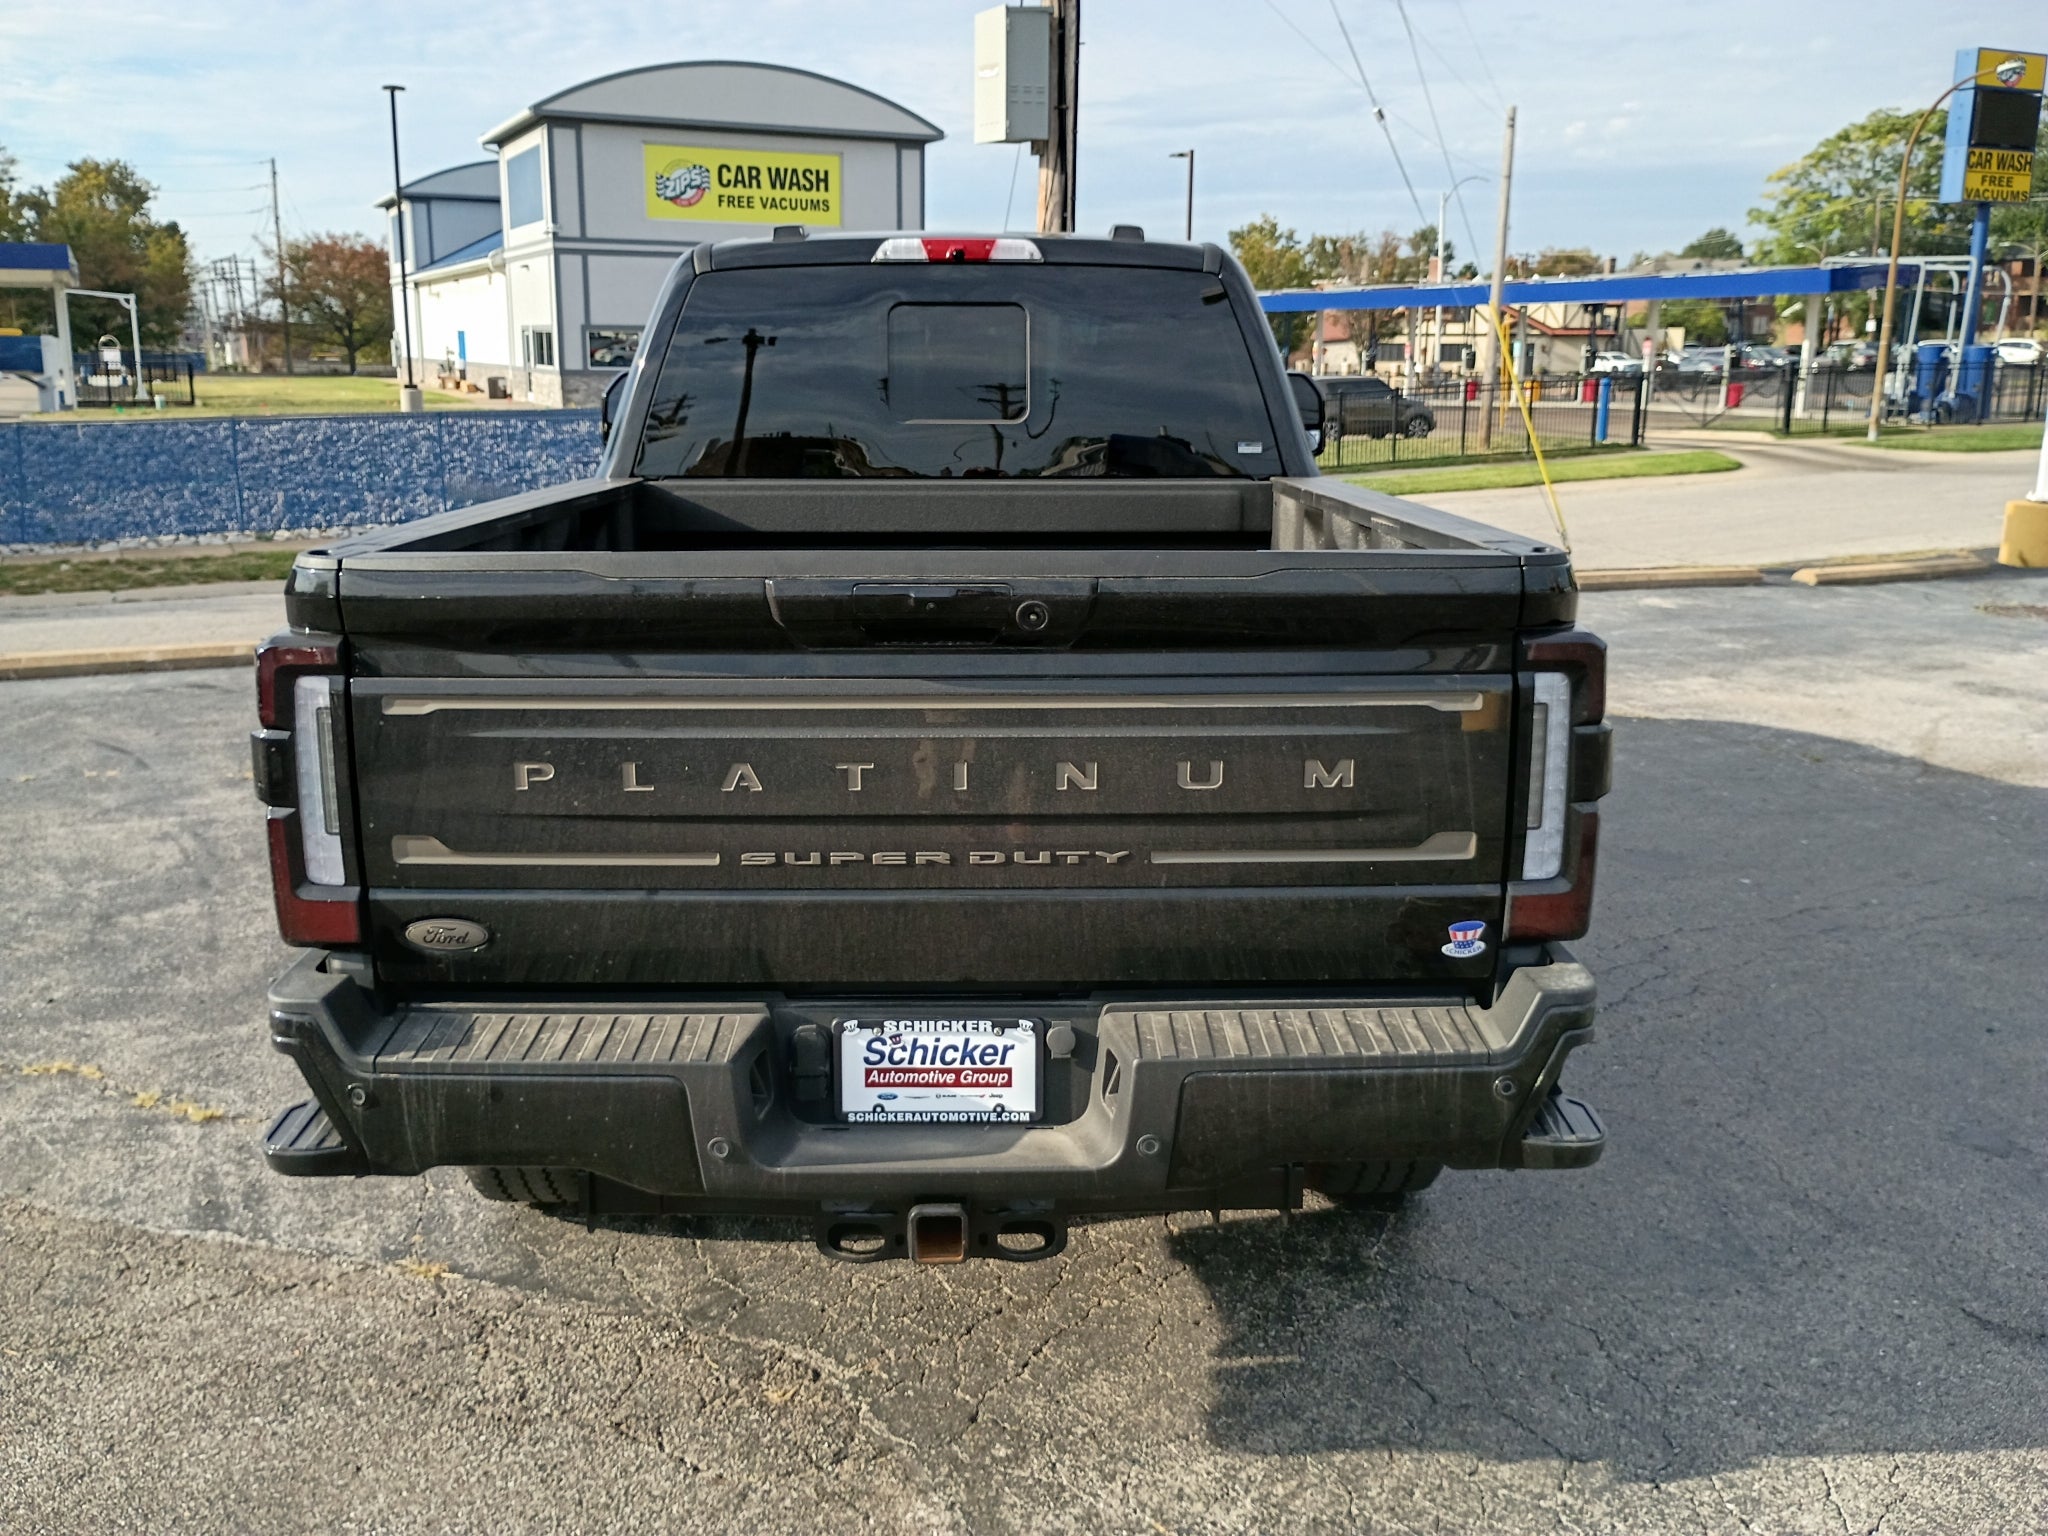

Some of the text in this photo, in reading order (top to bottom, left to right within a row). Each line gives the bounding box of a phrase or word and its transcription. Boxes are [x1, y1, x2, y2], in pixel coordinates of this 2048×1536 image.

[1967, 150, 2032, 172] CAR WASH
[664, 168, 702, 199] ZIPS
[717, 164, 829, 193] CAR WASH
[1981, 174, 2014, 188] FREE
[718, 194, 830, 212] FREE VACUUMS
[1965, 187, 2029, 202] VACUUMS
[514, 759, 1355, 792] PLATINUM
[740, 850, 1130, 866] SUPER DUTY
[423, 925, 470, 944] Ford
[1445, 945, 1482, 955] SCHICKER
[883, 1020, 993, 1033] SCHICKER
[863, 1036, 1015, 1066] Schicker
[867, 1069, 1009, 1086] Automotive Group
[848, 1111, 1030, 1122] SCHICKERAUTOMOTIVE.COM
